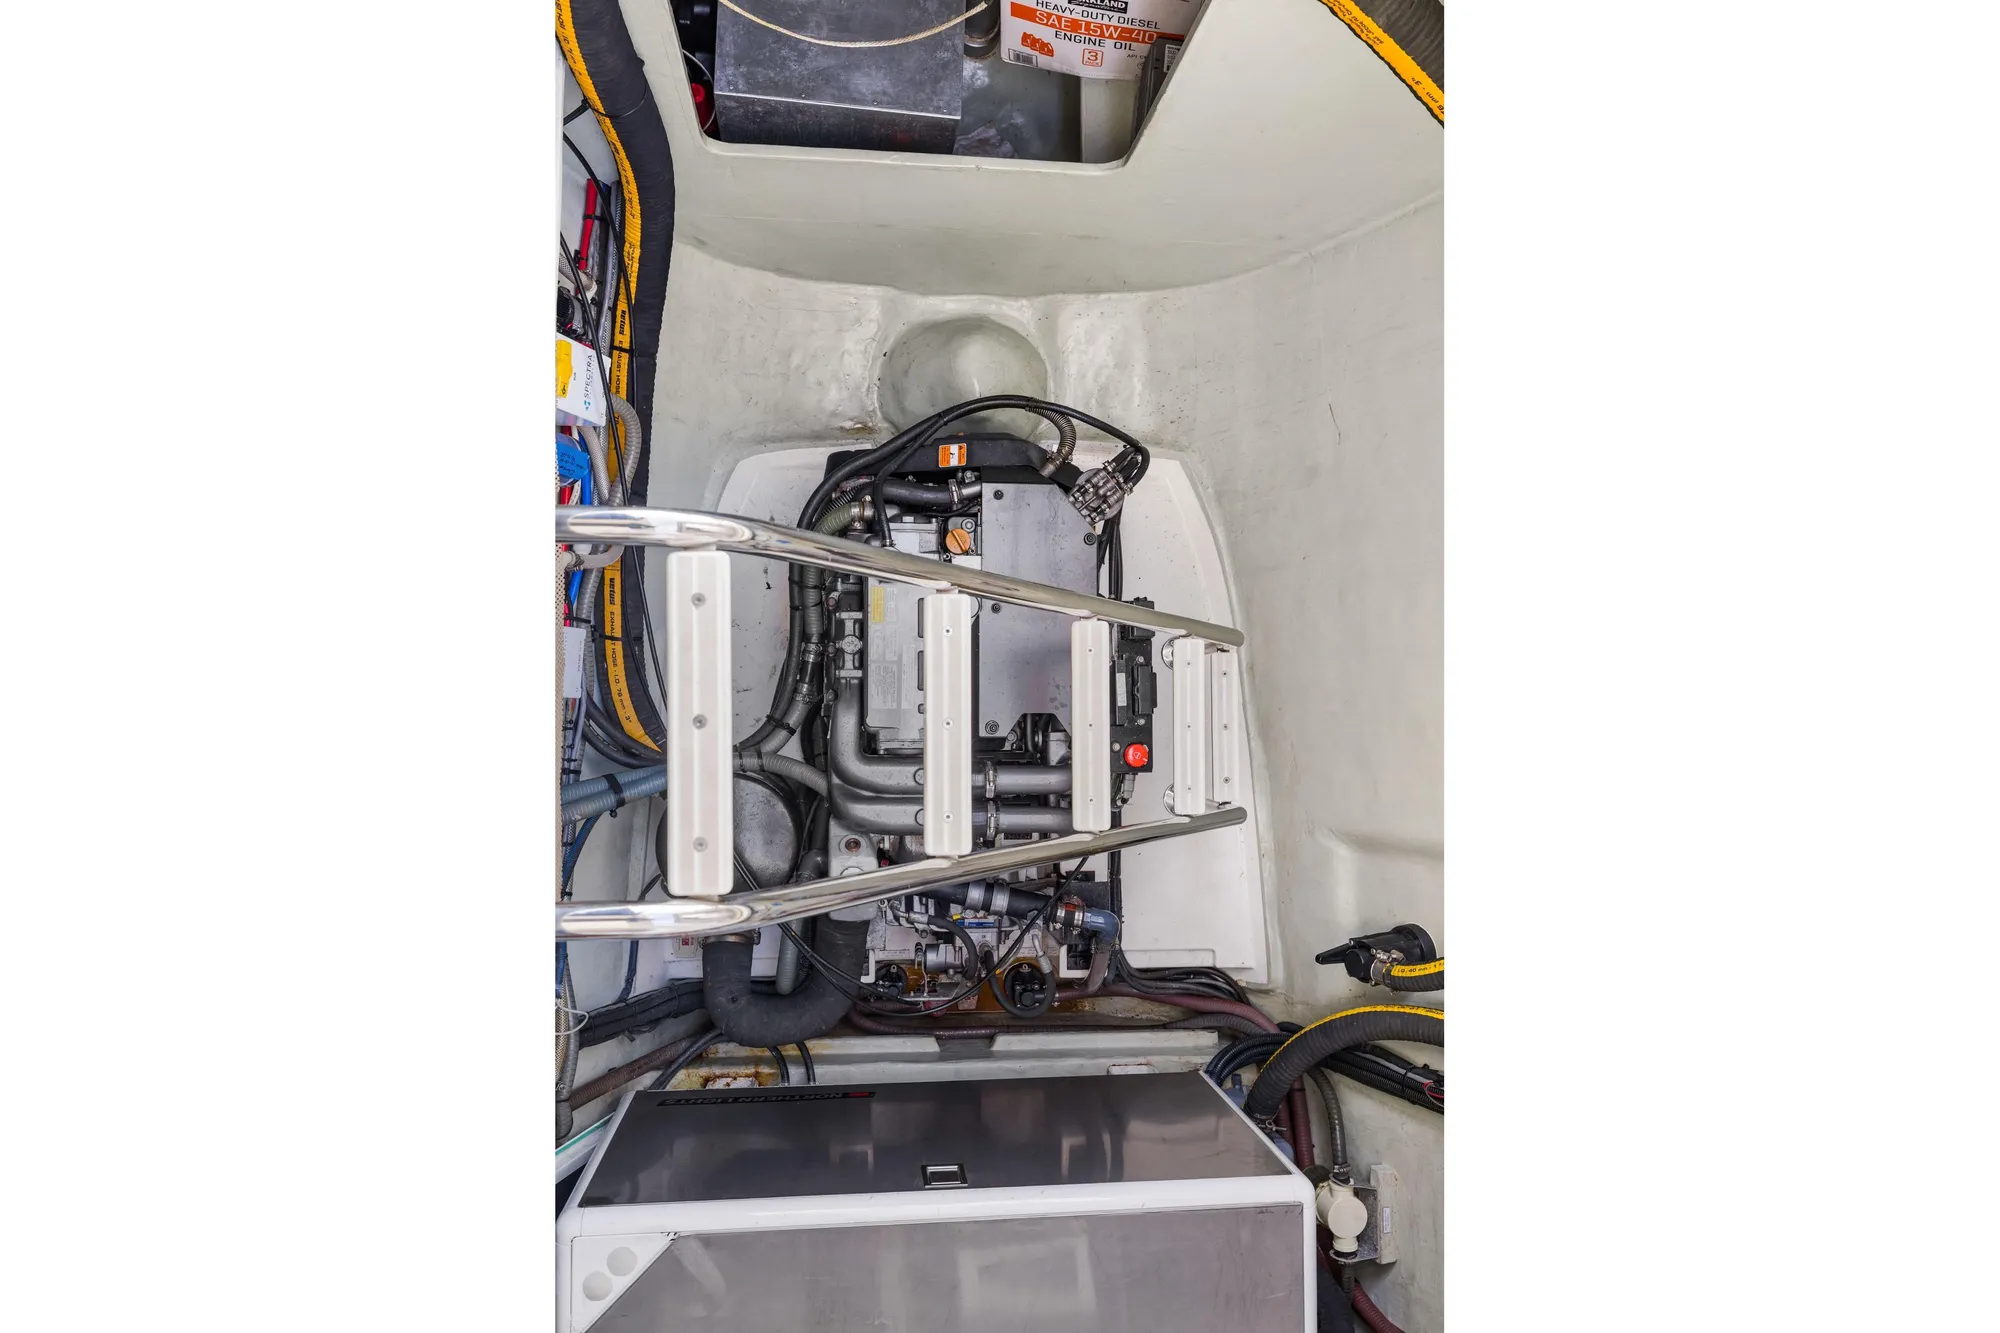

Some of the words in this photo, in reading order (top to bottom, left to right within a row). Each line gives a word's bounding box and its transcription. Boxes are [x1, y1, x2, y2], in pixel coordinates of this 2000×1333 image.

[1079, 0, 1126, 8] KLAND
[1036, 0, 1114, 23] HEAVY-DUTY
[1118, 16, 1160, 30] DIESEL
[1035, 10, 1073, 31] SAE
[1077, 20, 1157, 44] 15W-40
[1055, 31, 1106, 48] ENGINE
[1113, 41, 1136, 52] OIL
[1086, 51, 1098, 62] 3
[584, 354, 593, 399] SPECTRA
[664, 1096, 733, 1105] LIGHTS
[738, 1093, 843, 1103] NORTHERN
